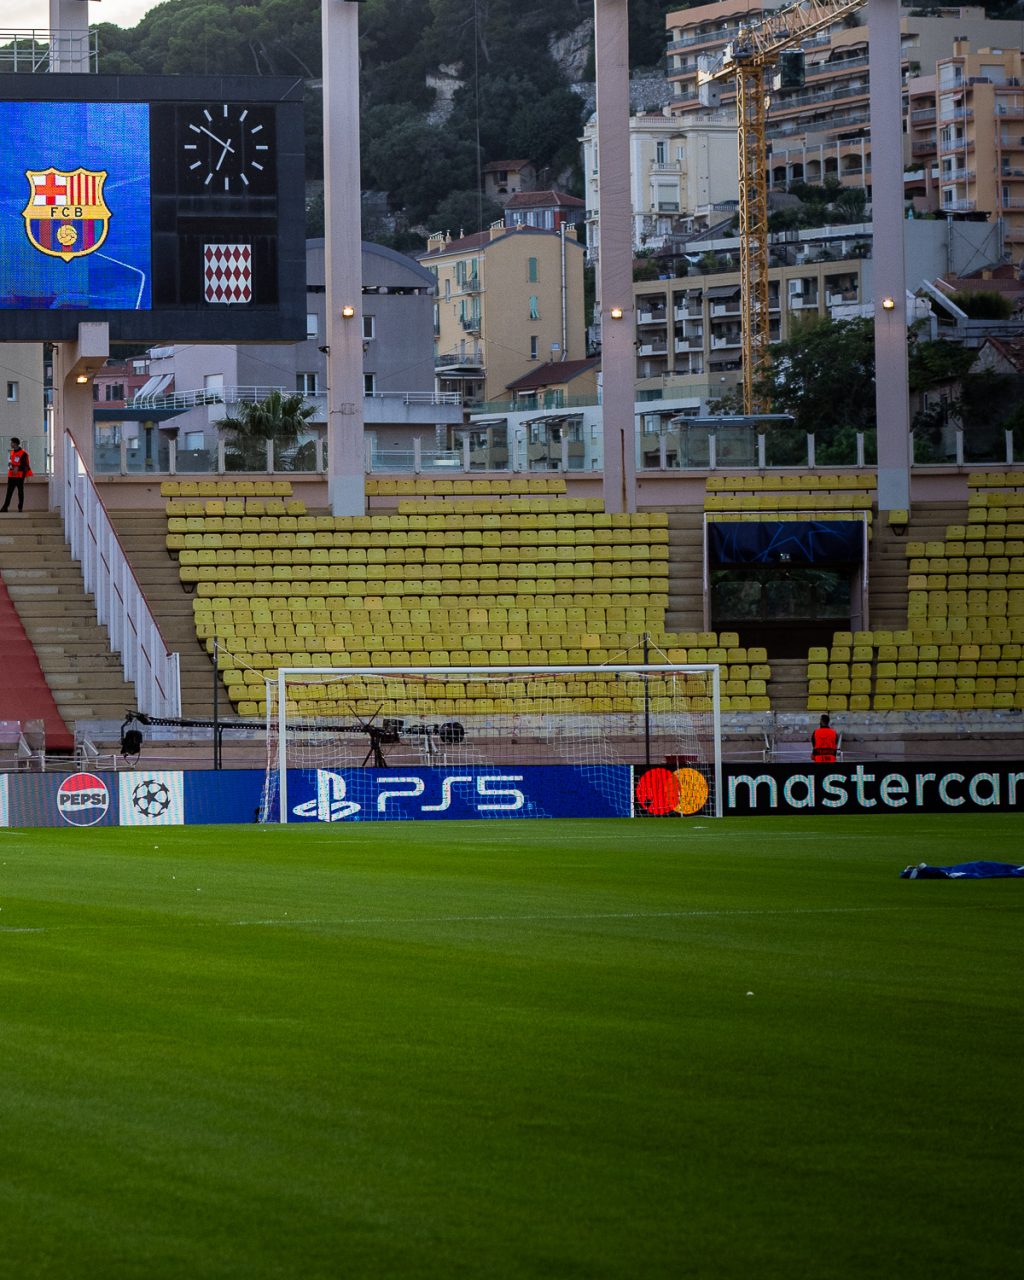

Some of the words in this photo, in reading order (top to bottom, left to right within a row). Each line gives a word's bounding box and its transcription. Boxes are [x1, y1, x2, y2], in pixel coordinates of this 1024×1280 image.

[59, 793, 107, 806] PEPSI
[377, 775, 524, 811] PS5
[728, 765, 1024, 808] mastercar
